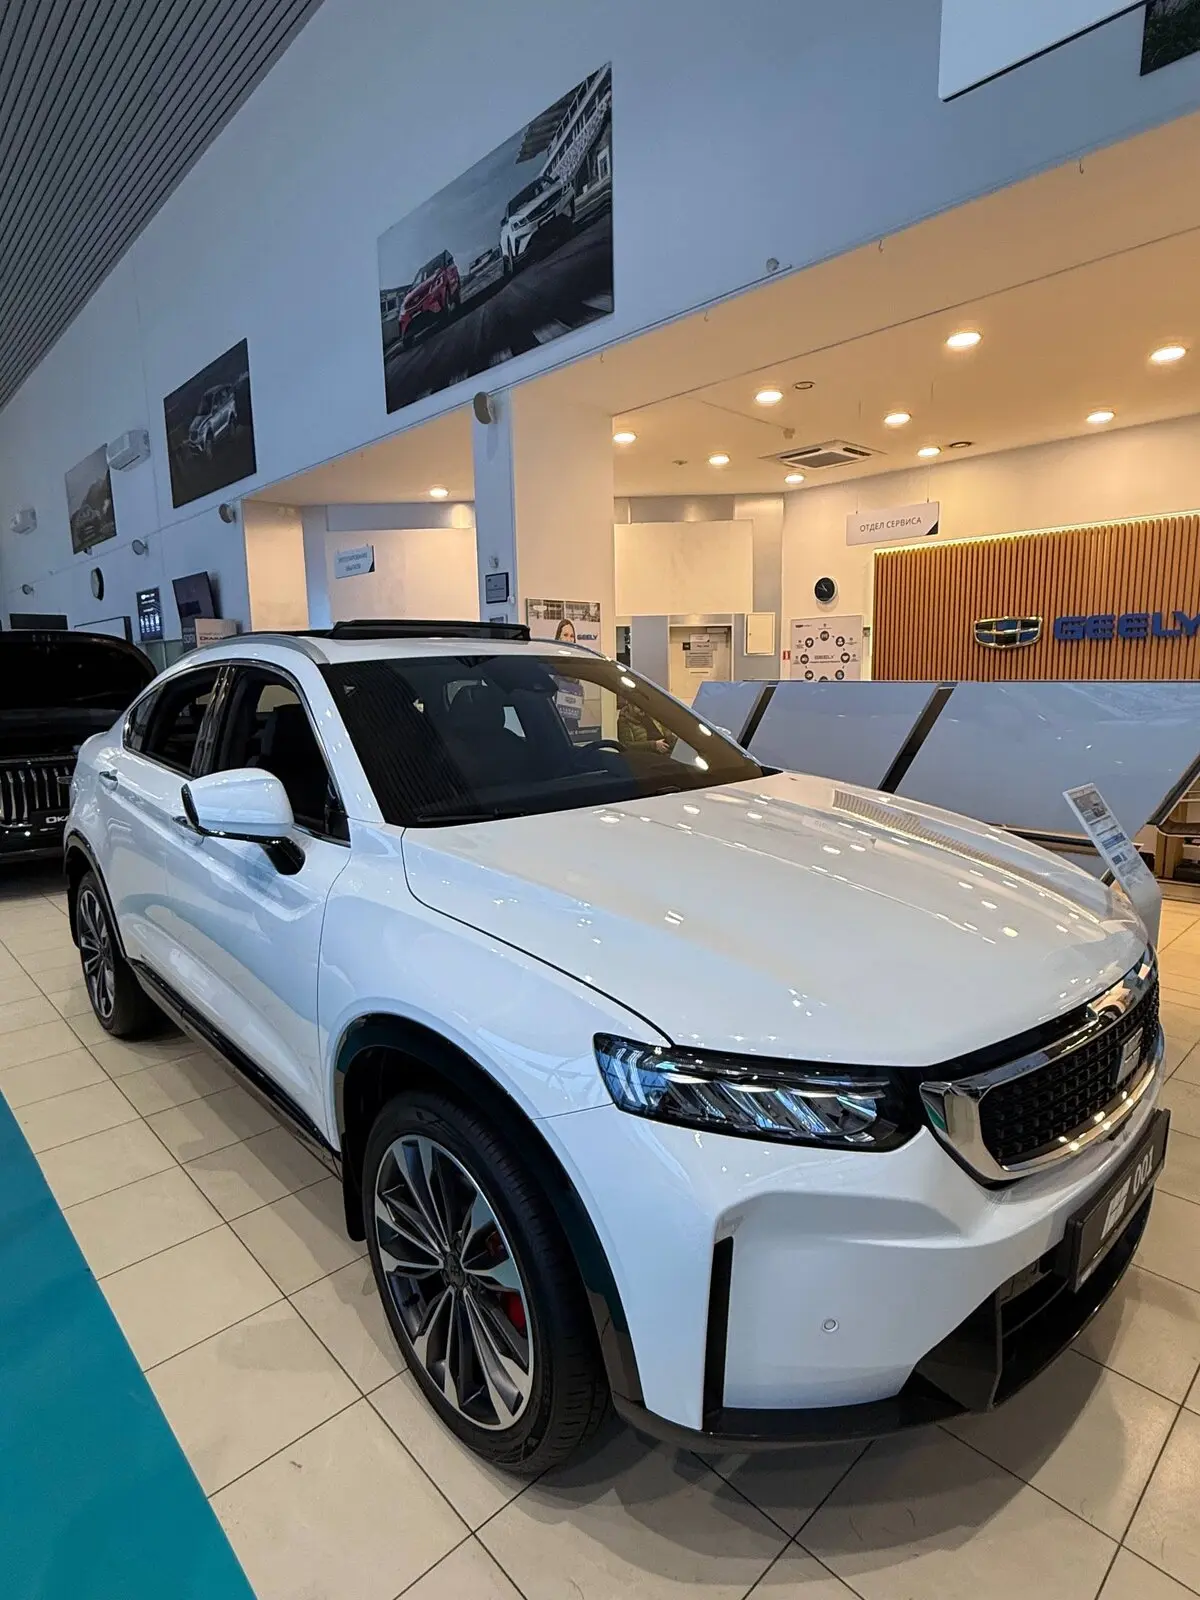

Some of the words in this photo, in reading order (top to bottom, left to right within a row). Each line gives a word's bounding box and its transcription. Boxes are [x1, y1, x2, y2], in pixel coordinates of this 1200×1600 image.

[860, 521, 885, 533] ОТДЕЛ
[886, 516, 922, 529] СЕРВИСА
[1053, 610, 1200, 640] GEELY
[1133, 1145, 1154, 1195] 001
